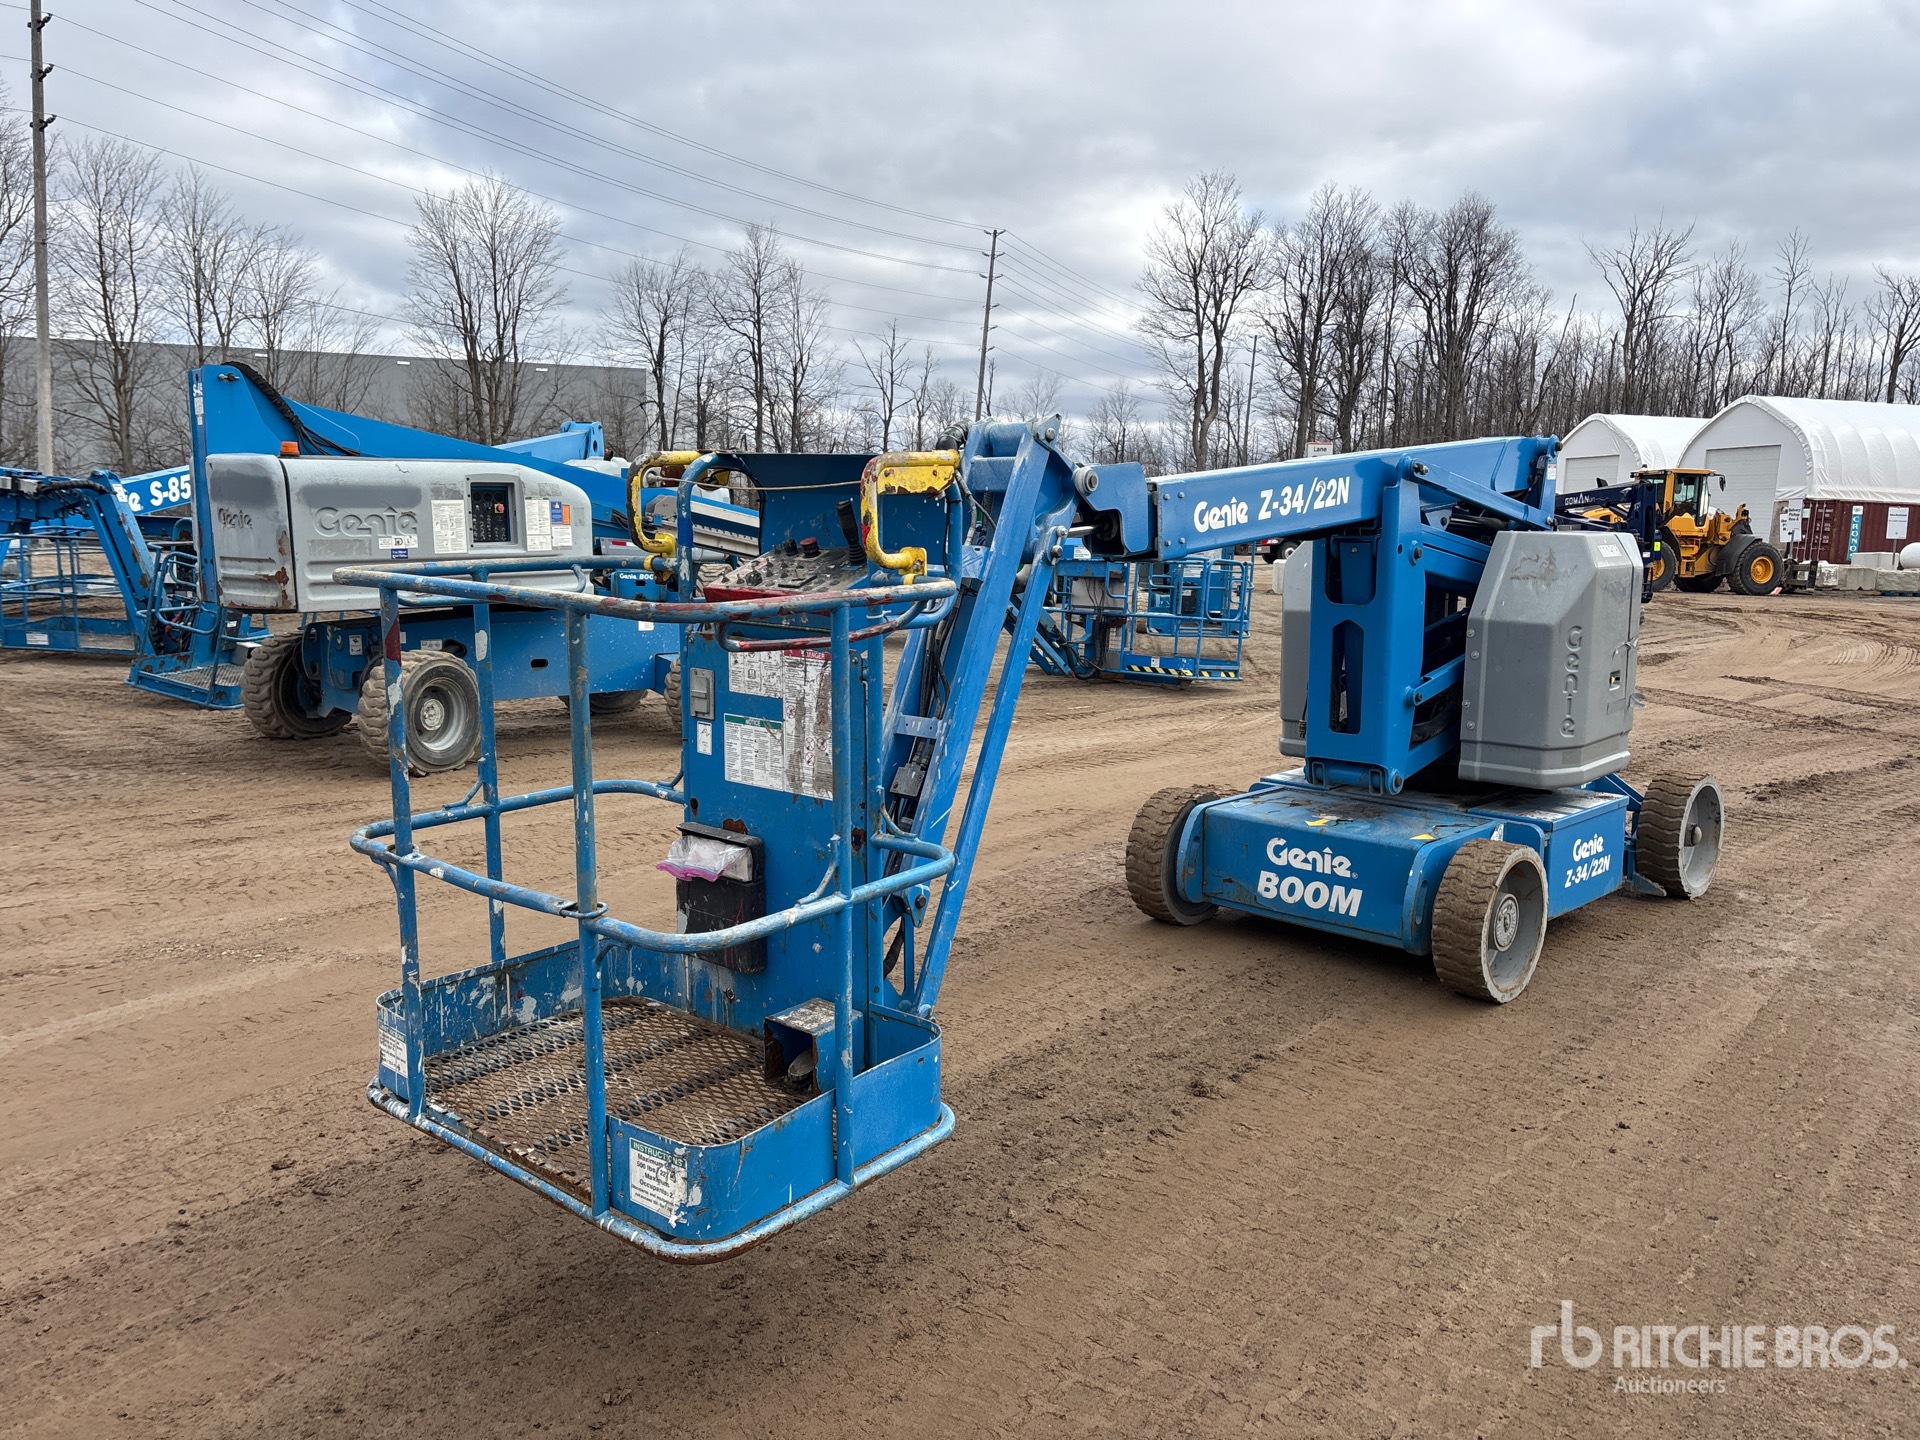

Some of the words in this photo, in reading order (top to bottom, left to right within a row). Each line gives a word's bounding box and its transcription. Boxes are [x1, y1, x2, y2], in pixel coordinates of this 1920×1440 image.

[149, 474, 192, 507] S-85
[1193, 496, 1249, 533] Genie
[1258, 476, 1350, 521] Z-34/22N
[313, 506, 419, 537] Genie
[1560, 625, 1583, 738] Genie
[1266, 837, 1352, 878] Genie
[1572, 833, 1604, 862] Genie
[1564, 854, 1611, 889] Z-34/22N
[1257, 870, 1363, 917] BOOM
